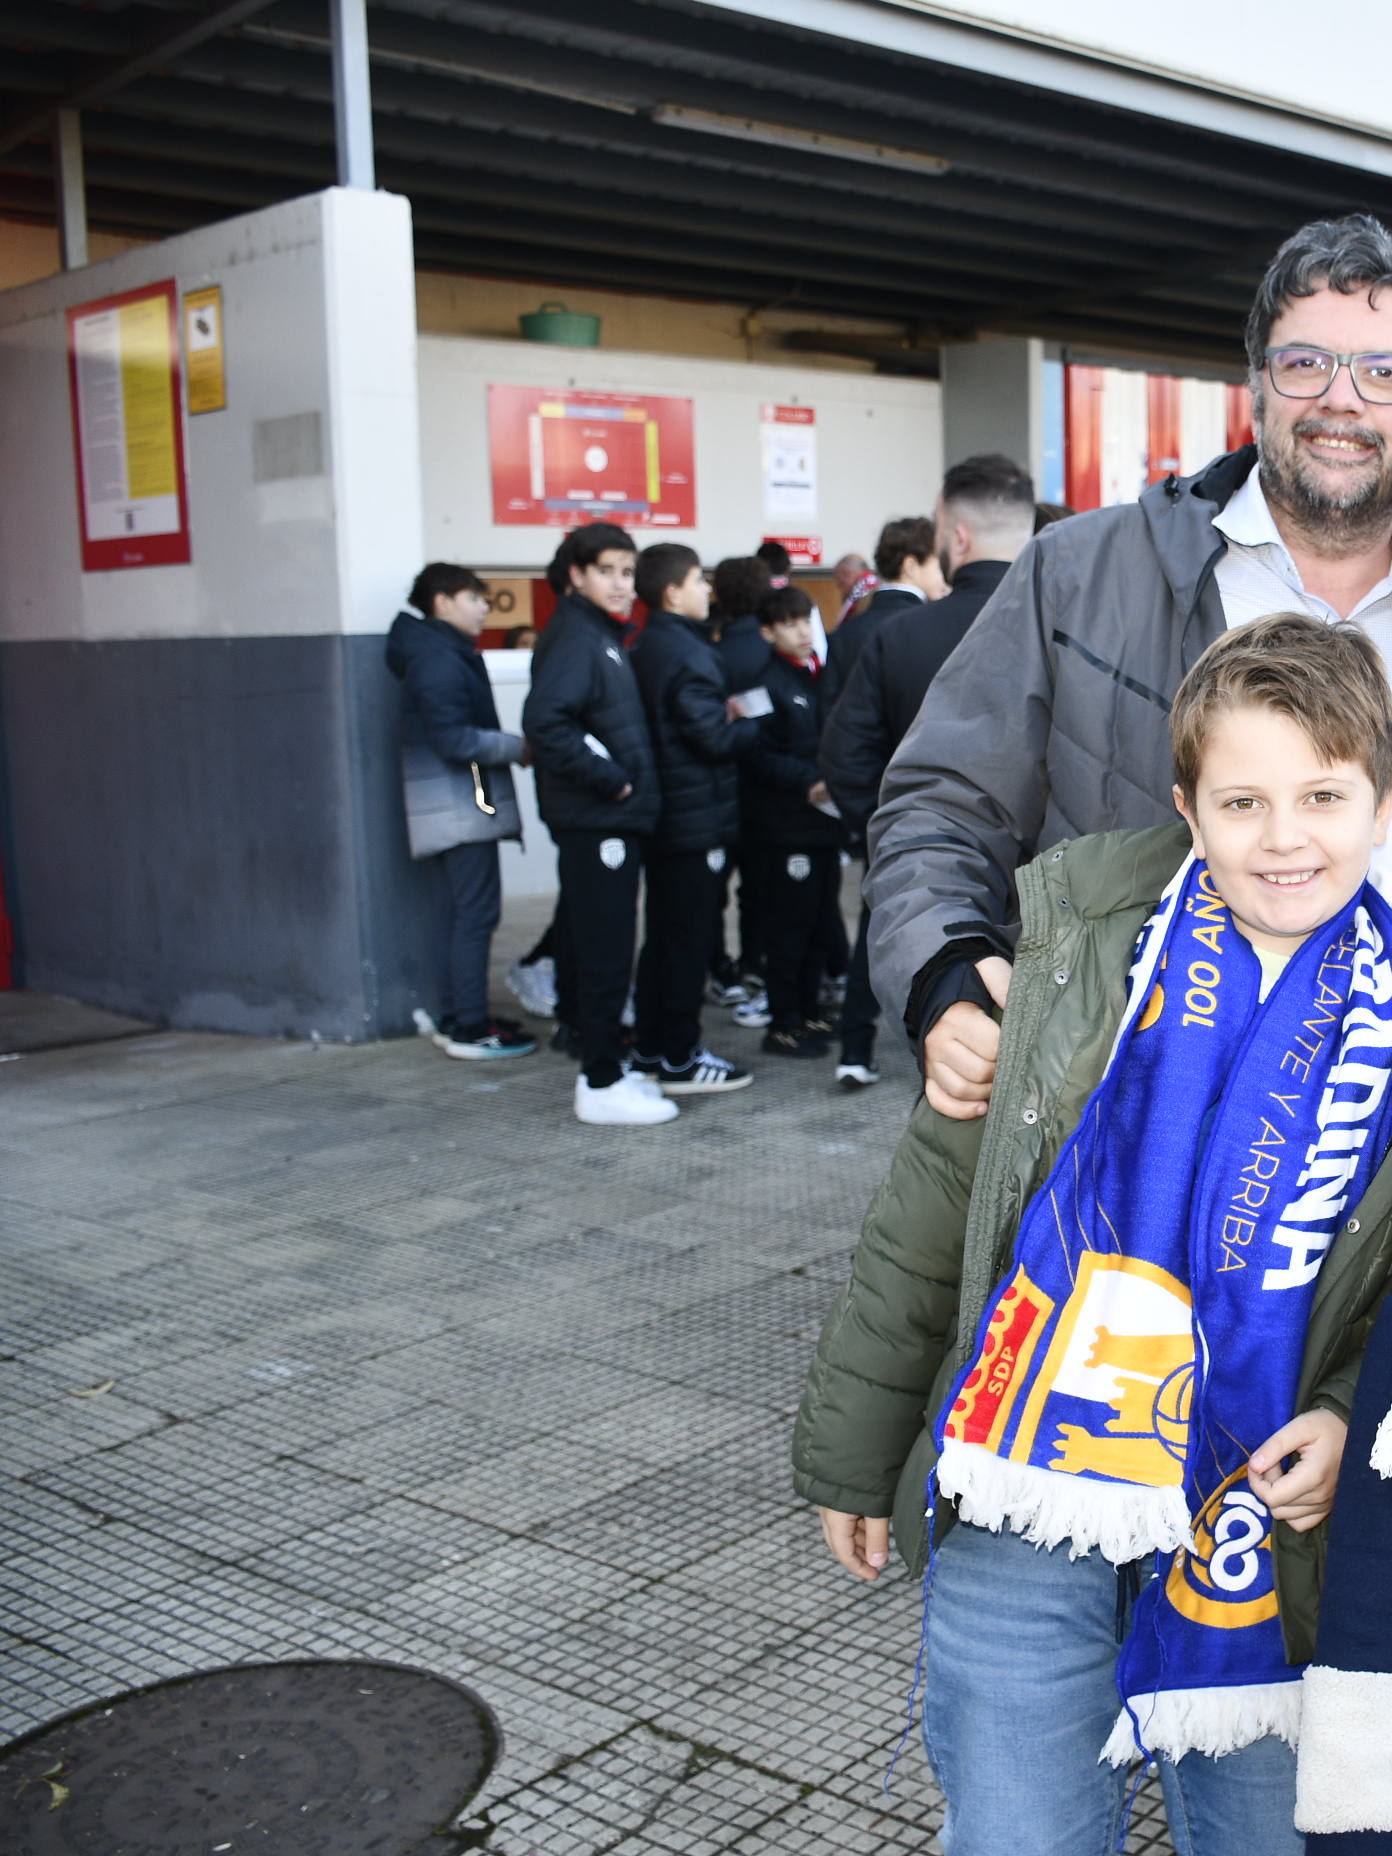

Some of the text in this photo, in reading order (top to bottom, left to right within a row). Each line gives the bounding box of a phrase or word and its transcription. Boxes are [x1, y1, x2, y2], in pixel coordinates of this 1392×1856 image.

[1182, 961, 1221, 1028] 100
[1269, 1091, 1301, 1118] Y
[1216, 1116, 1287, 1273] ARRIBA
[988, 1345, 1014, 1397] SDP
